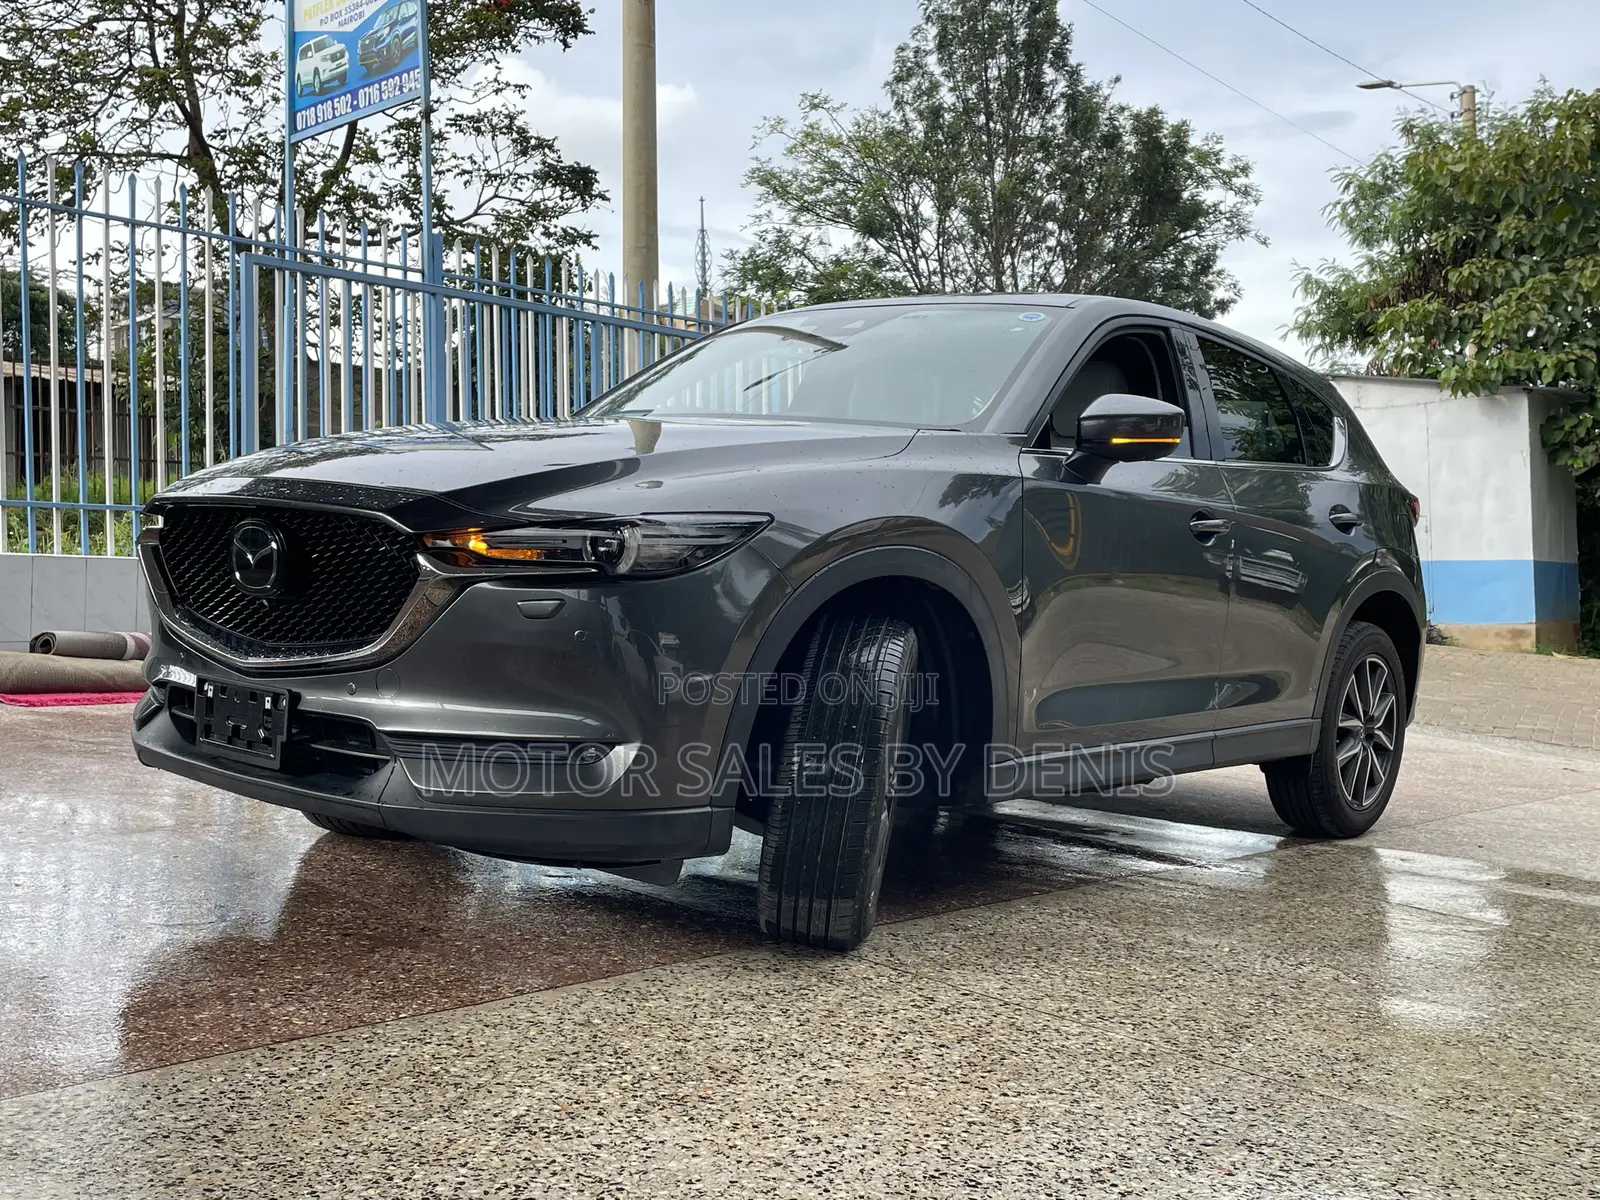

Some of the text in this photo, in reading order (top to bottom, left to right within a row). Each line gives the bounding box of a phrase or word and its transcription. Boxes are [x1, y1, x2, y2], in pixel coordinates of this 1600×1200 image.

[330, 9, 344, 22] BOX
[338, 10, 365, 28] NAIROBI
[295, 106, 316, 131] 0718
[316, 101, 333, 123] 918
[334, 93, 352, 117] 502
[358, 83, 380, 109] 0716
[381, 75, 401, 100] 592
[402, 68, 421, 93] 945
